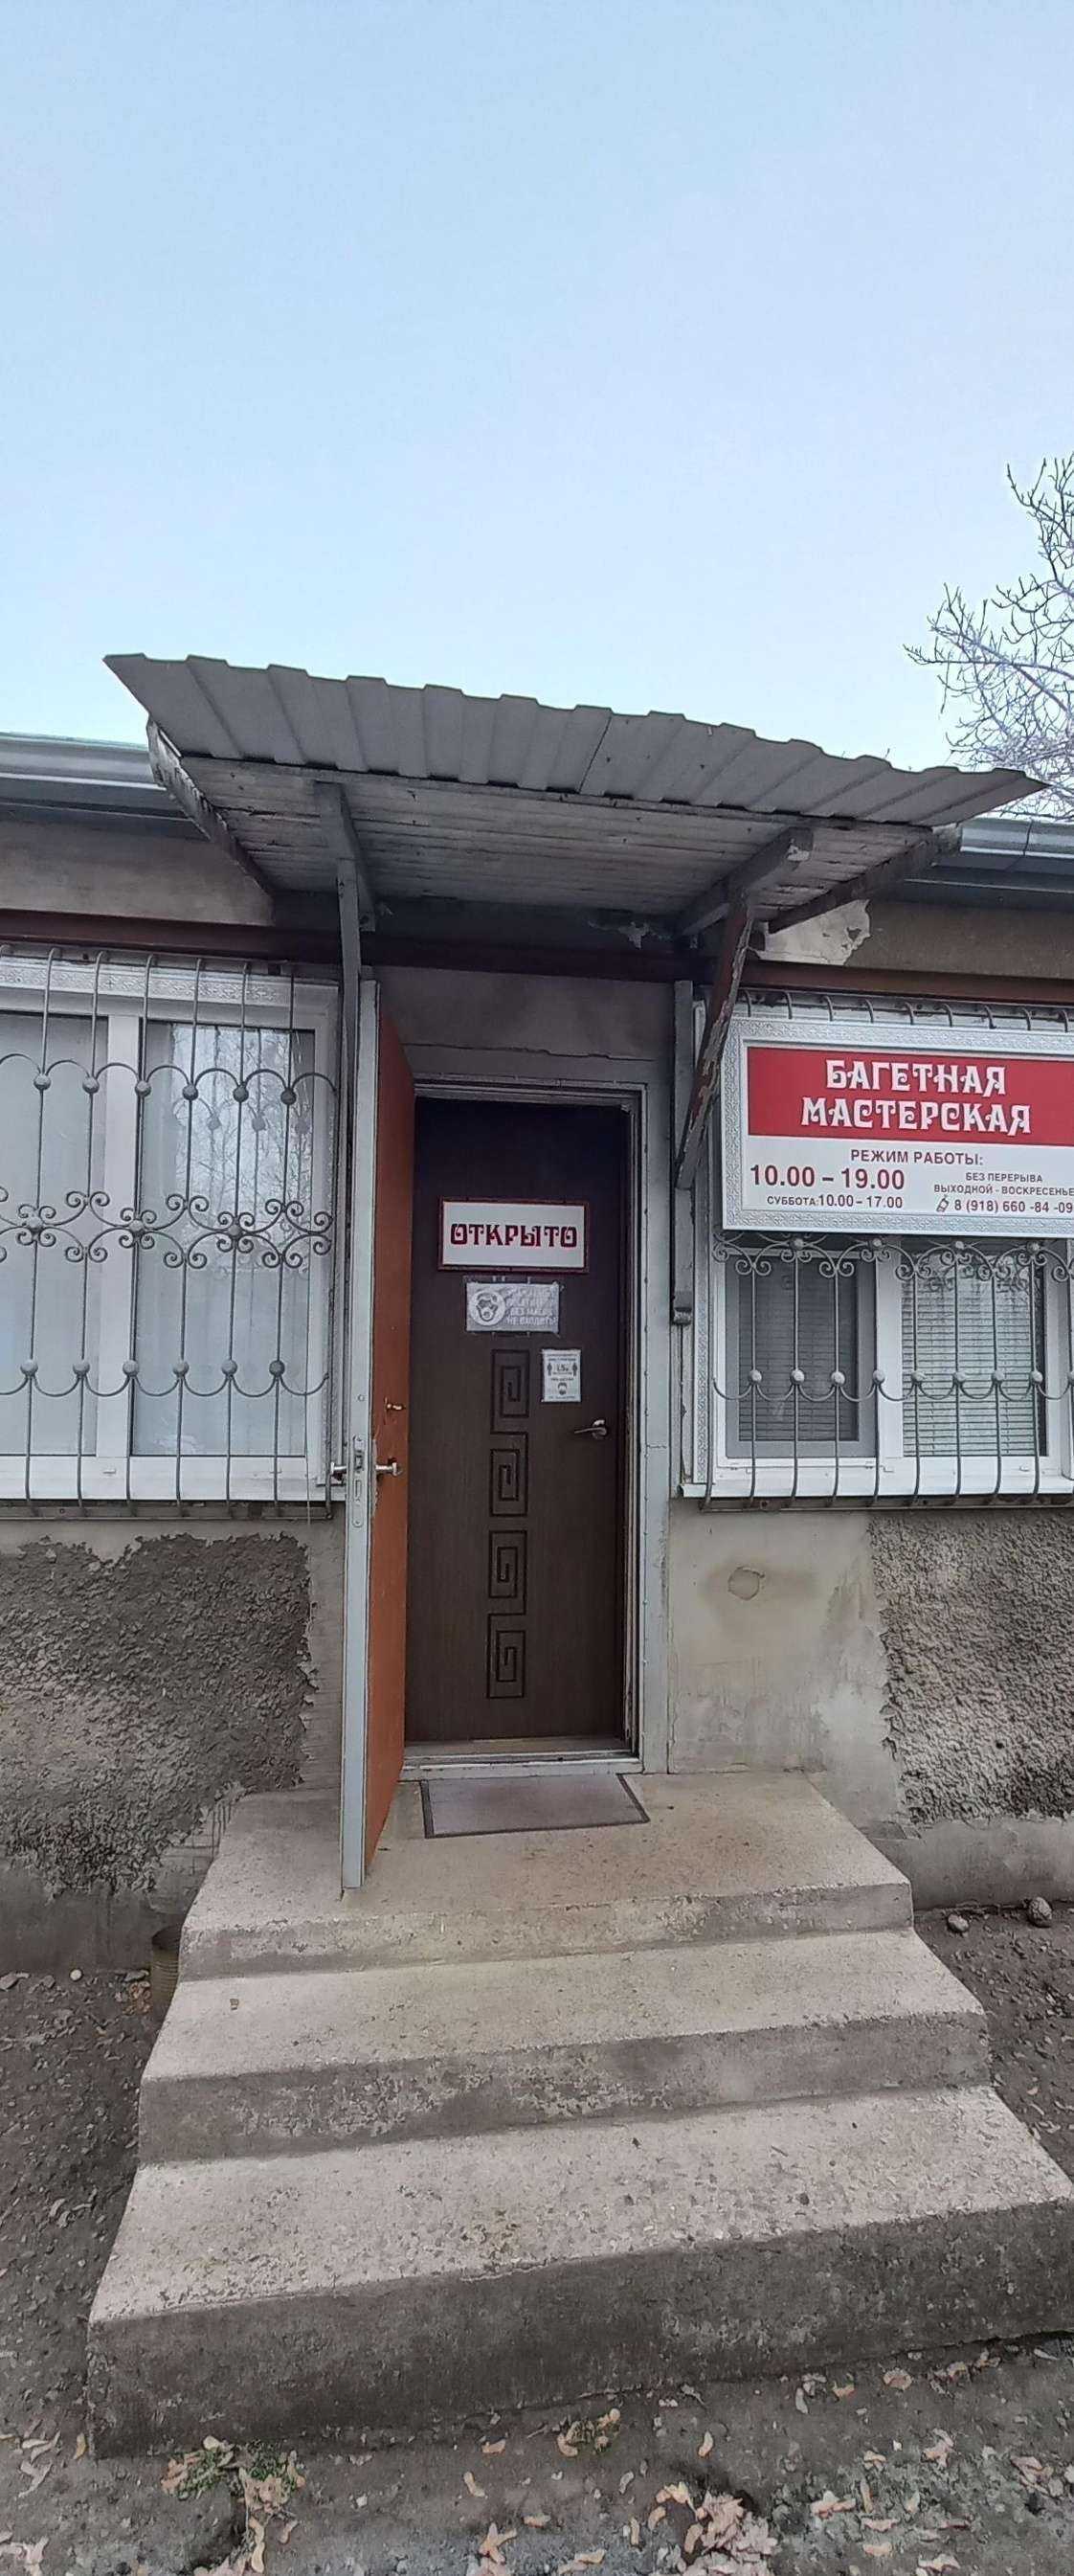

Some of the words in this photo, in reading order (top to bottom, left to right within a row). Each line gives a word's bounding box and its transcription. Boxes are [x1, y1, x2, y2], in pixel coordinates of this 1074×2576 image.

[825, 1059, 1006, 1097] БАГЕТНАЯ
[800, 1096, 1032, 1137] МАСТЕРСКАЯ
[850, 1149, 908, 1163] РЕЖИМ
[913, 1151, 984, 1165] РАБОТЫ:
[750, 1164, 816, 1187] 10.00
[840, 1167, 905, 1190] 19.00
[965, 1171, 986, 1182] БЕЗ
[987, 1172, 1043, 1184] ПЕРЕРЫВА
[933, 1183, 994, 1195] ВЫХОДНОЙ
[1001, 1186, 1074, 1197] ВОСКРЕСЕНЬЕ
[865, 1195, 904, 1209] 17.00
[953, 1199, 962, 1211] 8
[966, 1199, 999, 1213] (918)
[1002, 1200, 1026, 1212] 660
[450, 1223, 578, 1248] ОТКРЫТО
